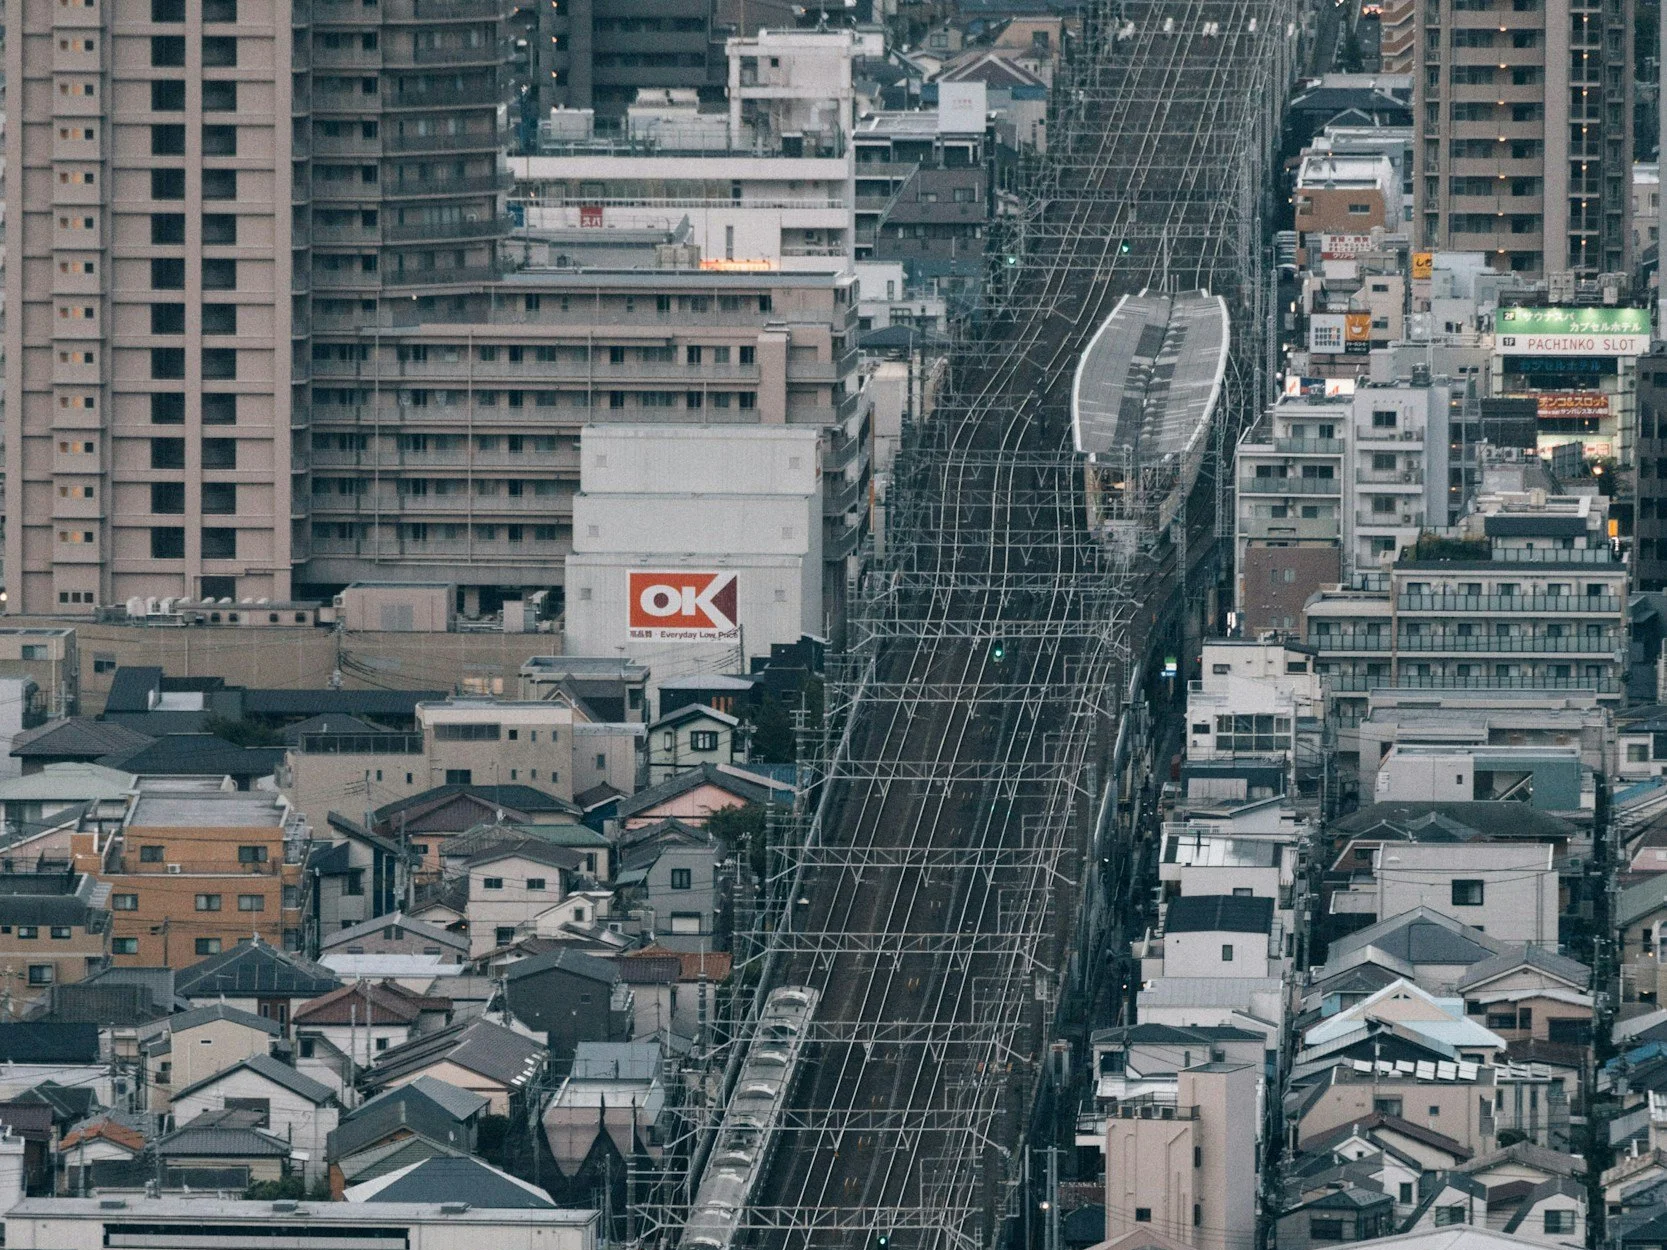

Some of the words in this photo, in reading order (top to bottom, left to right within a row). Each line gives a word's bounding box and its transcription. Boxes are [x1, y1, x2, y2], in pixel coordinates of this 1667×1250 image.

[1527, 338, 1595, 351] PACHINKO
[1603, 338, 1637, 351] SLOT
[640, 572, 738, 629] OK
[660, 631, 697, 640] Everyday
